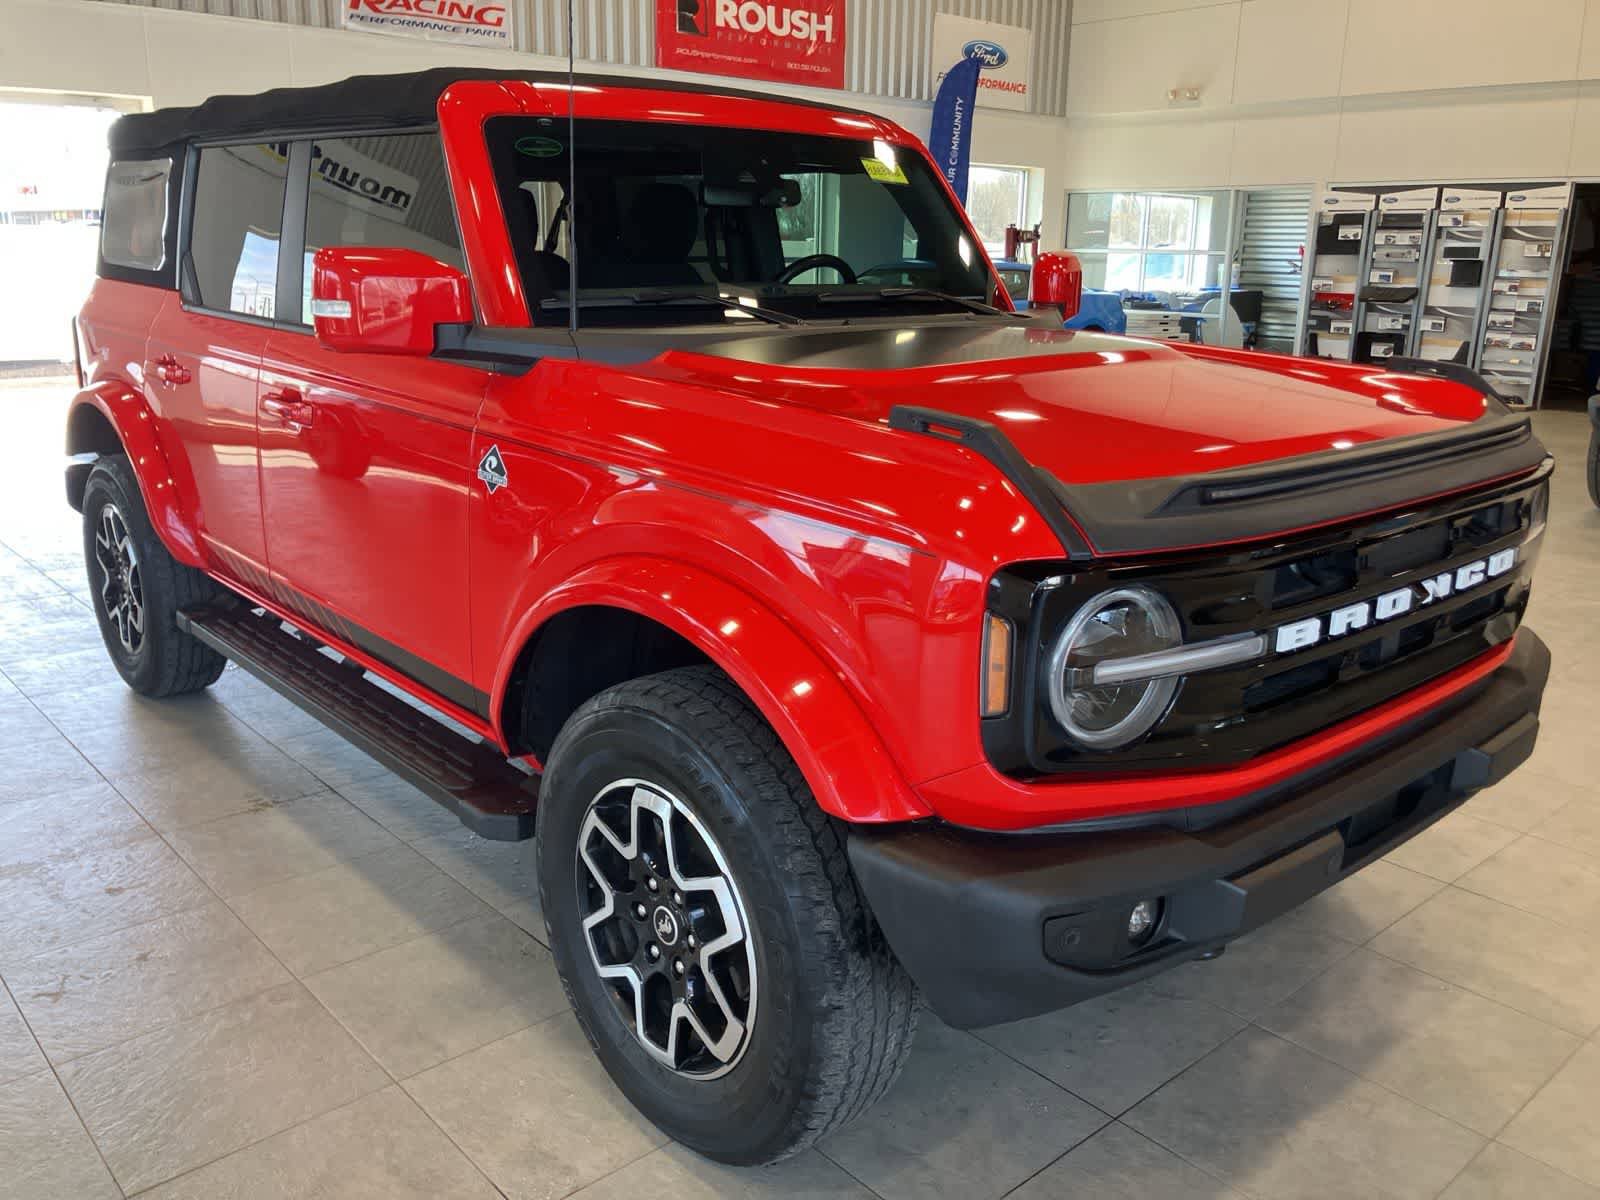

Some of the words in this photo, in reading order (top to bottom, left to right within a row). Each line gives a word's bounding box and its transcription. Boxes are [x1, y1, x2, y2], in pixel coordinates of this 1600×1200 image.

[350, 13, 463, 33] PERFORMANCE
[465, 27, 507, 39] PARTS
[715, 0, 833, 43] ROUSH
[949, 96, 964, 165] COMMUNITY
[1275, 548, 1517, 653] BRONCO
